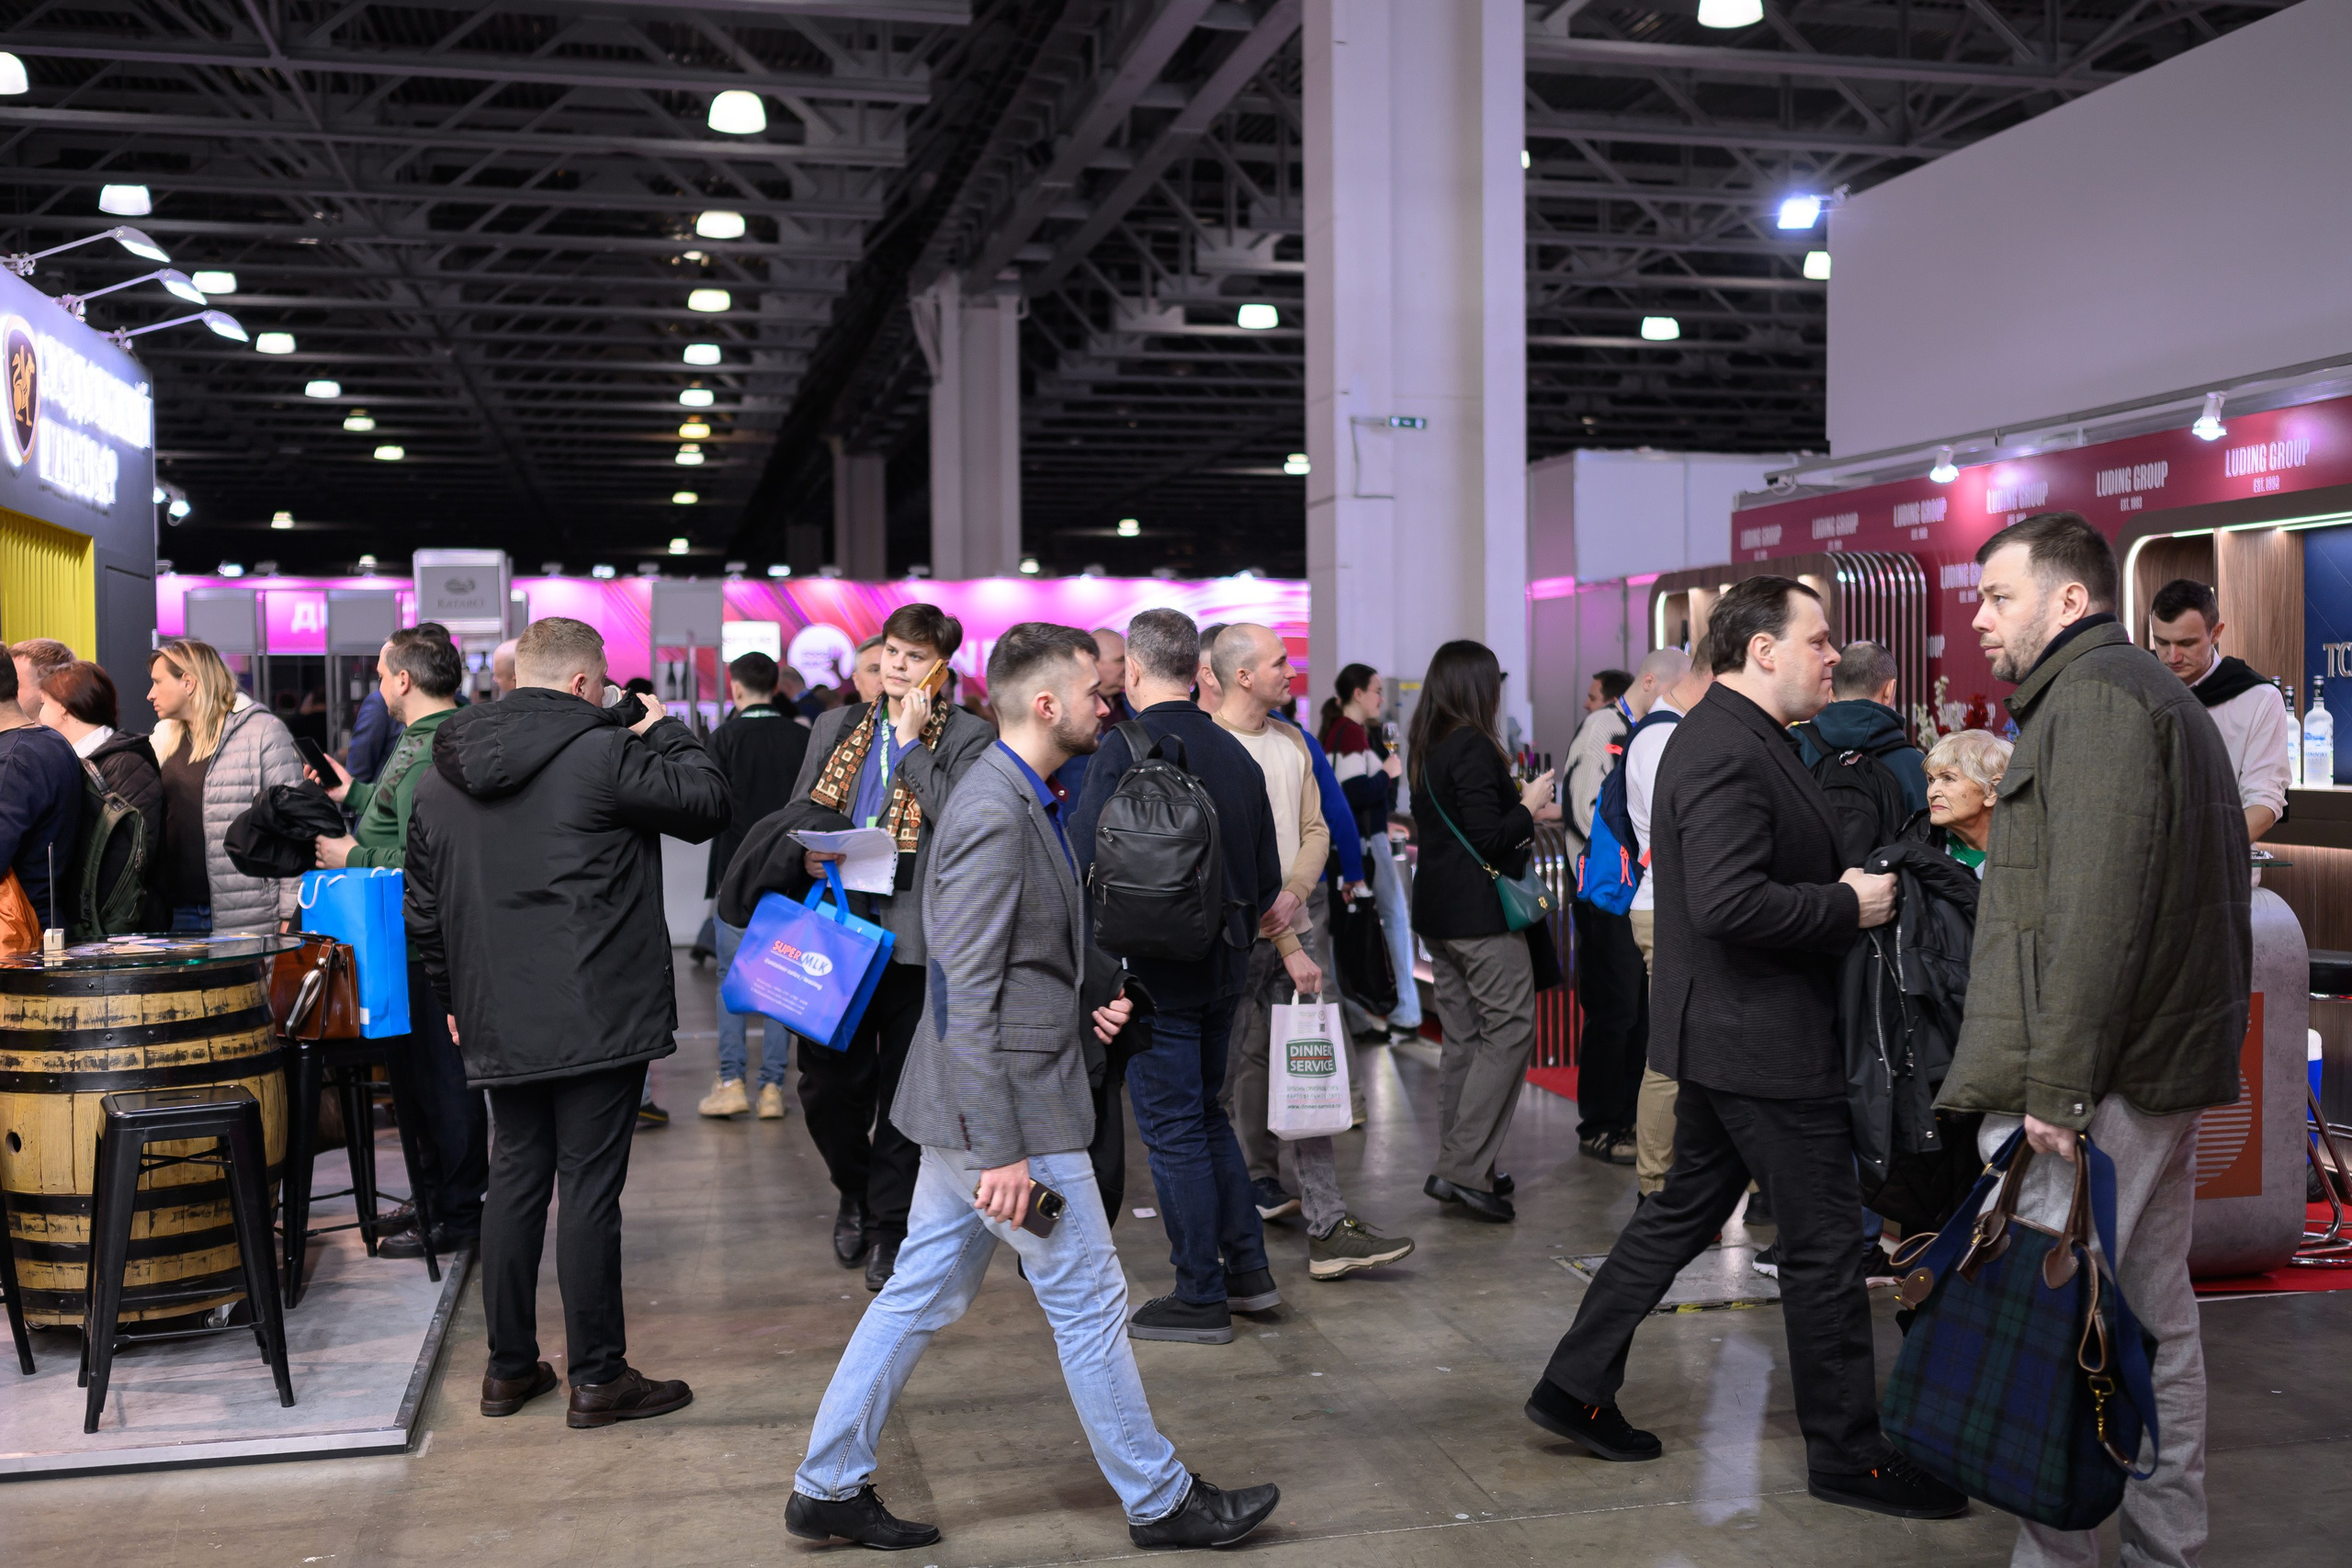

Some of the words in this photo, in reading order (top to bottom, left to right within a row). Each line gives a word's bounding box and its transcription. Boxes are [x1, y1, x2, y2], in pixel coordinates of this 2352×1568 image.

[2225, 444, 2267, 478] LUDING
[2269, 437, 2311, 471] GROUP
[2096, 467, 2132, 497] LUDING
[2132, 460, 2169, 492] GROUP
[1894, 502, 1920, 528] LUDING
[1920, 497, 1947, 524] GROUP
[1940, 562, 1969, 589] LUDING
[772, 940, 802, 961] SUPER
[803, 954, 830, 975] MLK
[1290, 1044, 1332, 1057] DINNER
[1290, 1059, 1334, 1072] SERVICE
